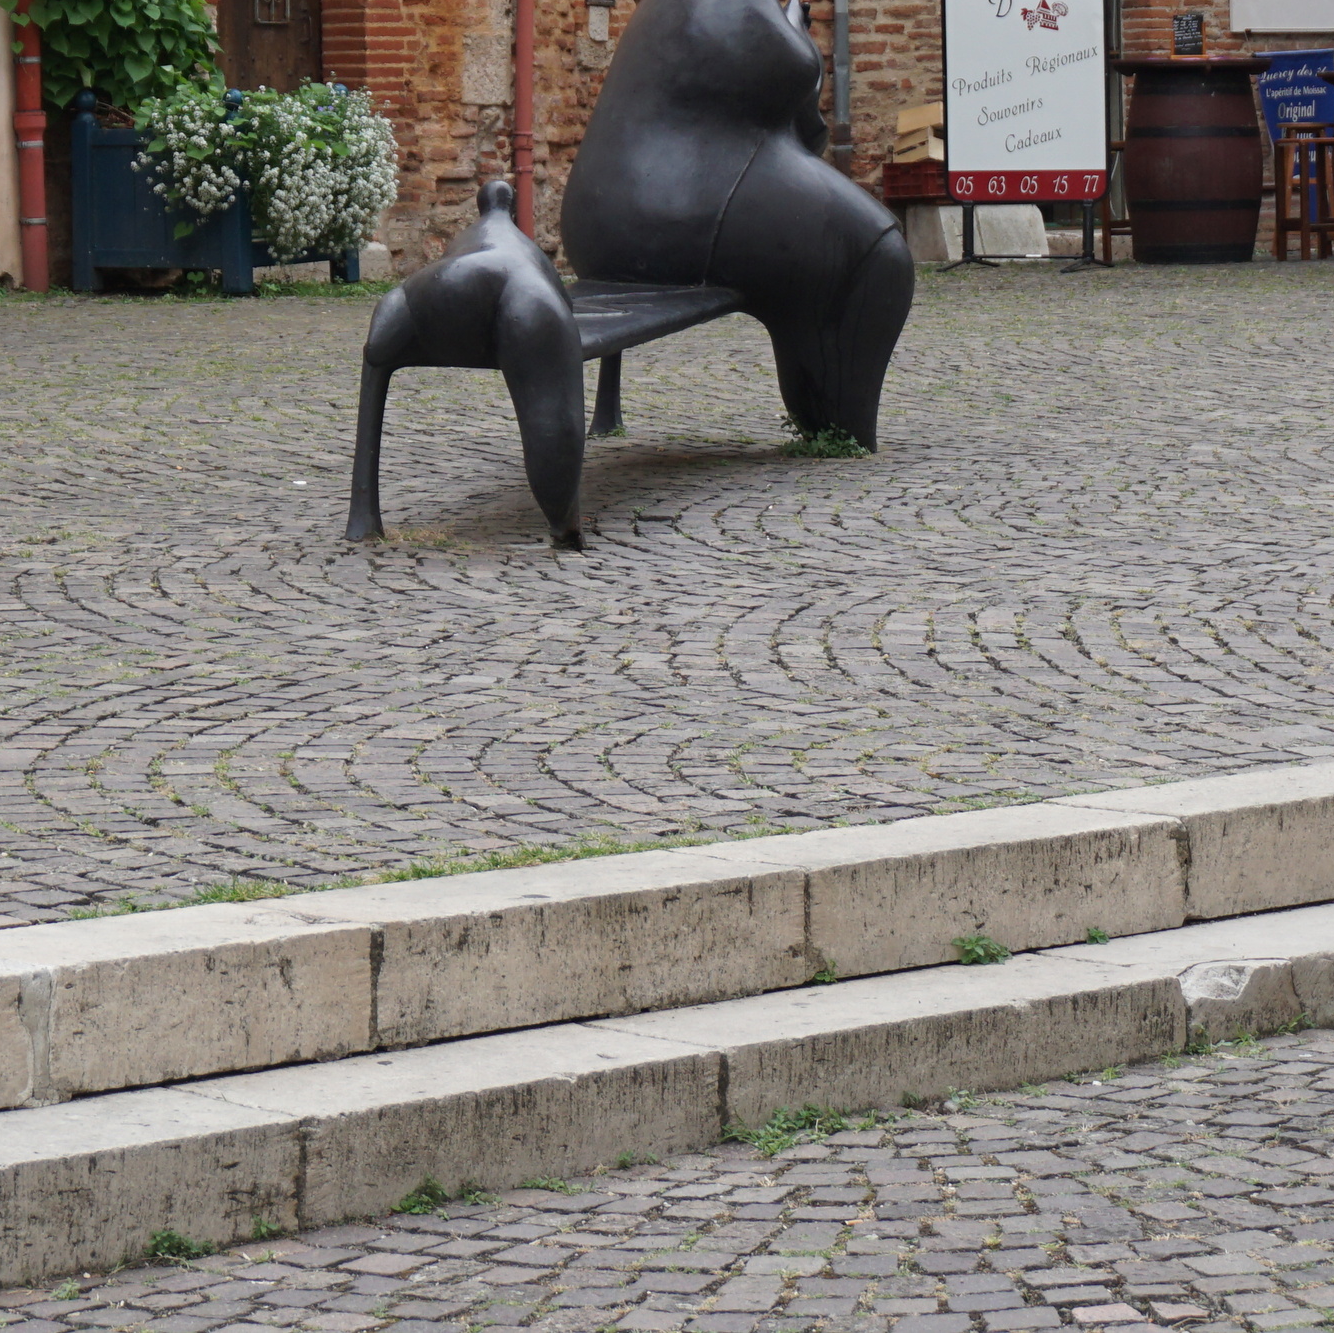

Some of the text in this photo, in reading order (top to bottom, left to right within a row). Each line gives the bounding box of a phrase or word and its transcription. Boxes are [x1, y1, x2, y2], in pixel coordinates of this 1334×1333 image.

[952, 45, 1098, 97] Produits Régionaux
[1266, 85, 1327, 98] L'apéritif de Moissac
[977, 97, 1044, 126] Souvenirs
[1278, 99, 1316, 122] Original
[1004, 127, 1063, 153] Cadeaux
[956, 175, 1100, 195] 05 63 05 15 77
